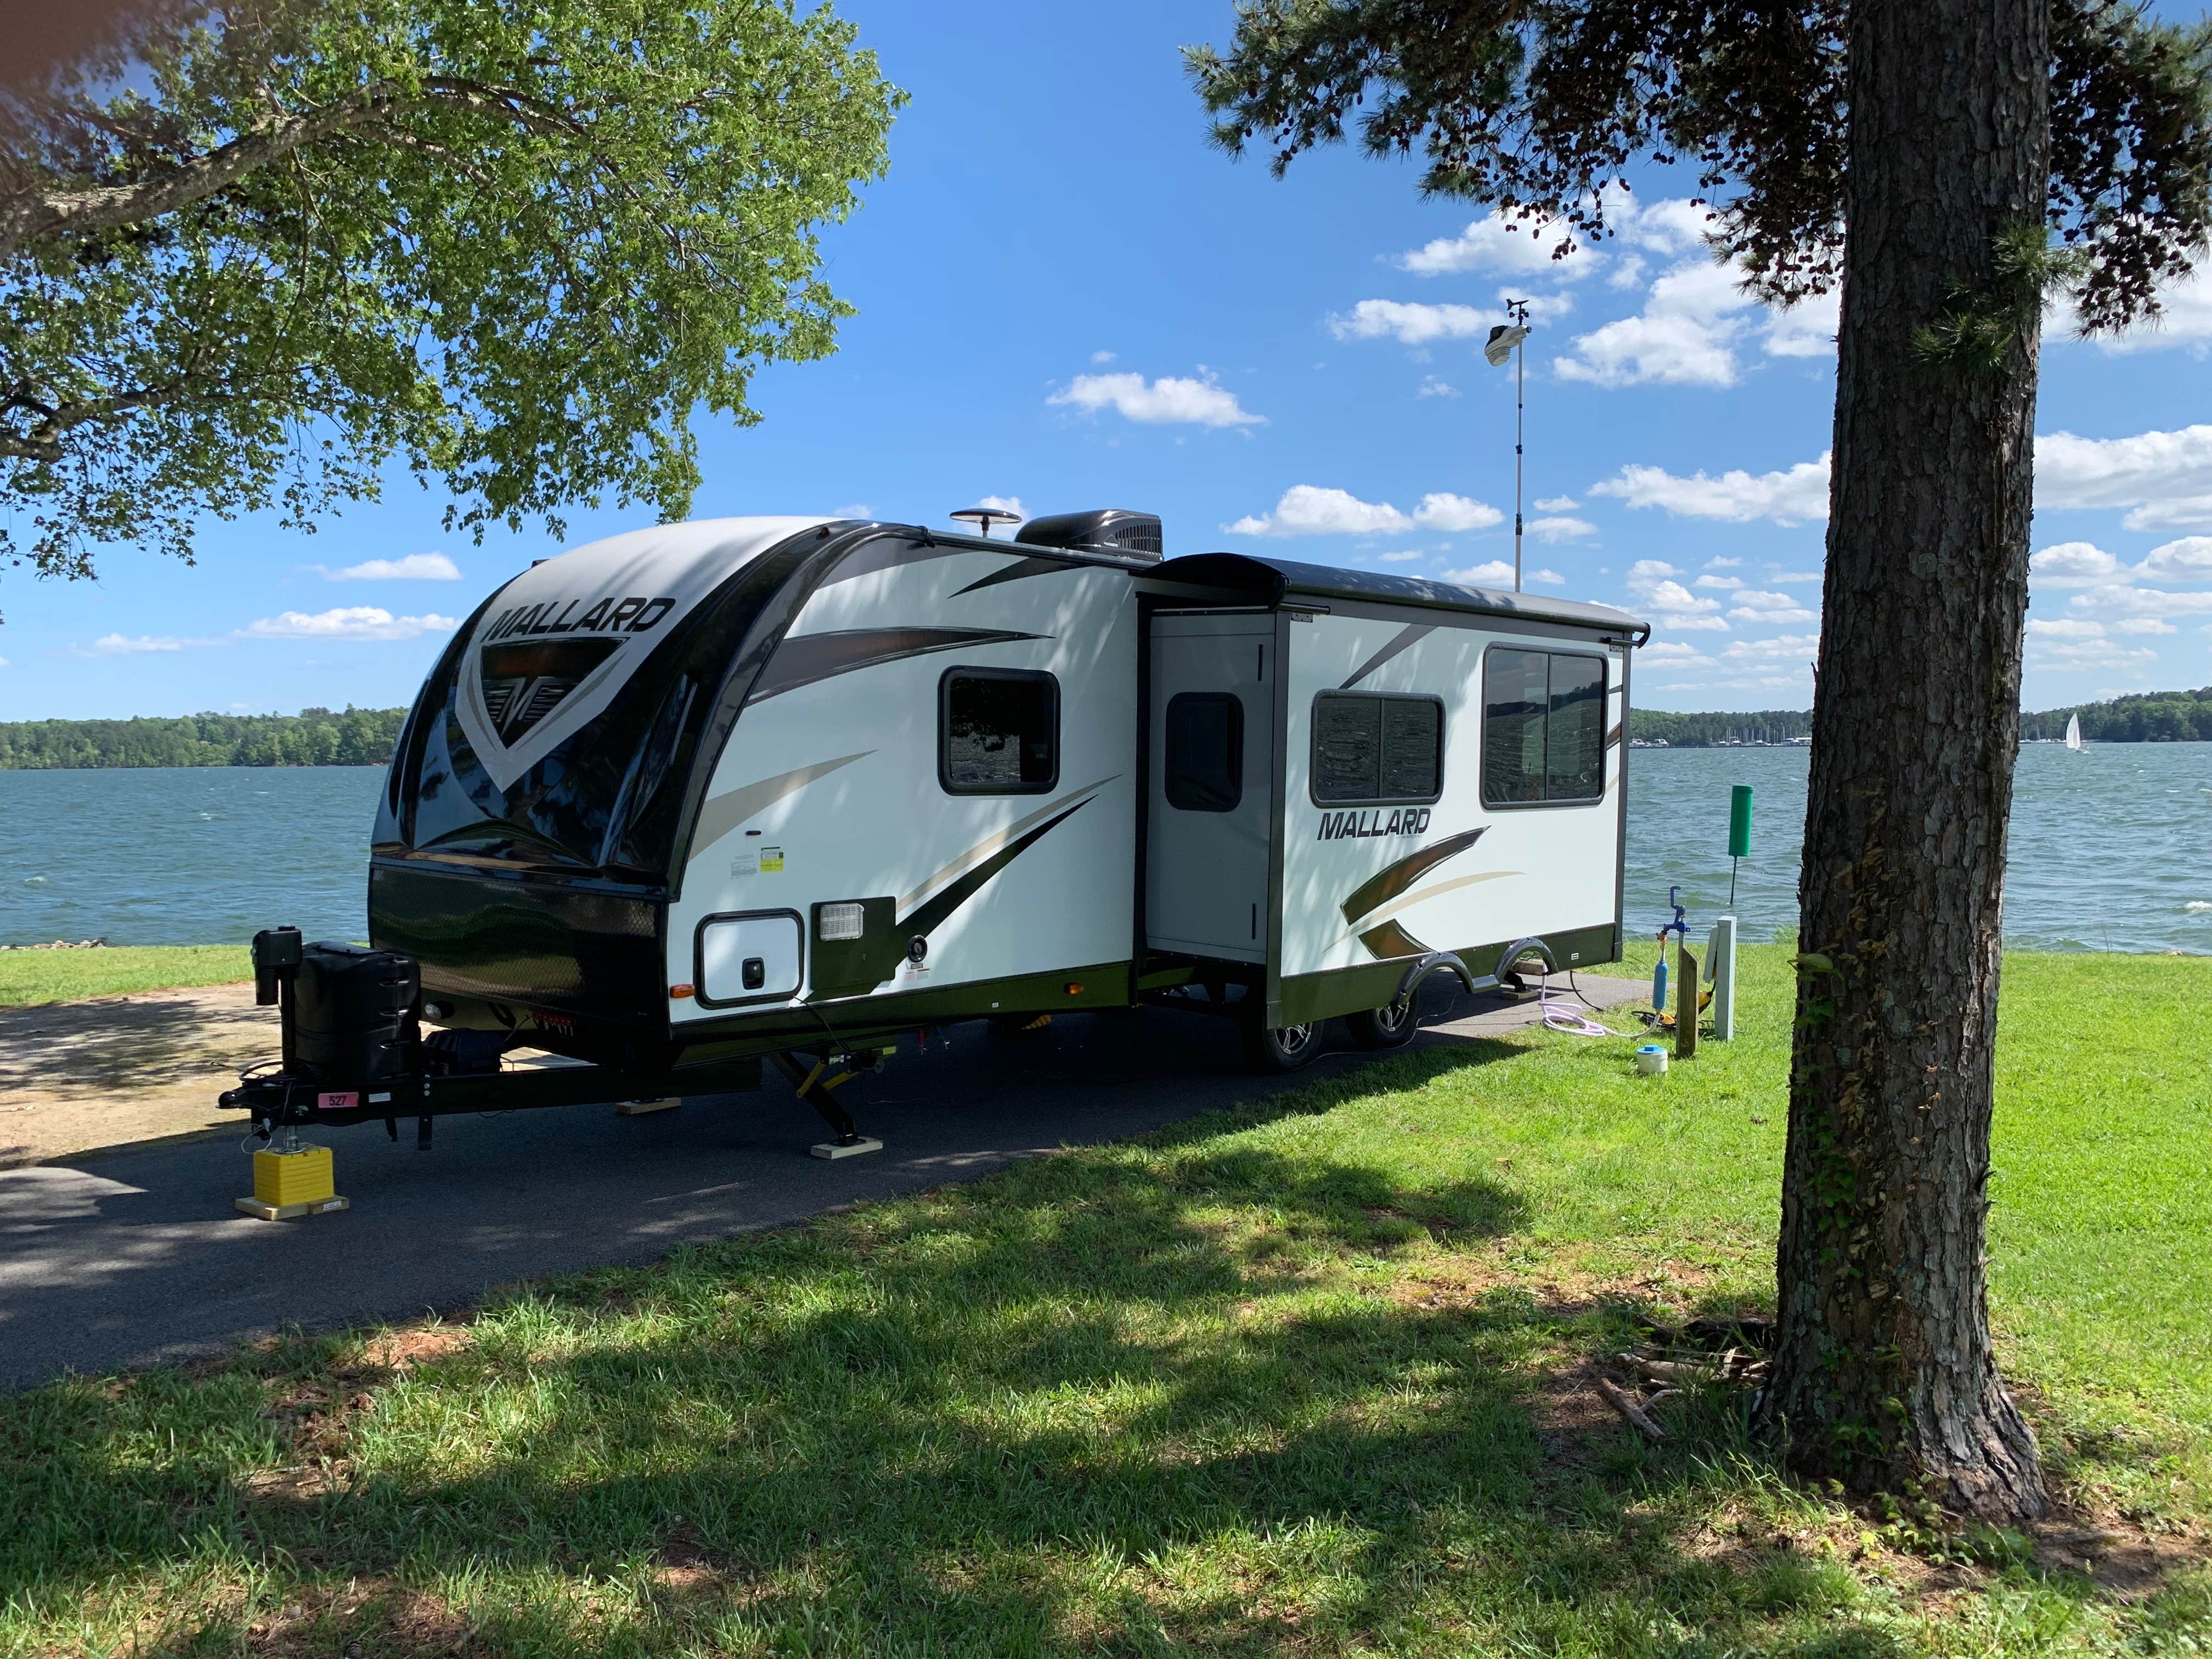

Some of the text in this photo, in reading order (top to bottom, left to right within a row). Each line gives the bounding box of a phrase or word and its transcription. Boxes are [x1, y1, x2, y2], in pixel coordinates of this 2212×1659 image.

[479, 597, 676, 643] MALLARD
[1317, 808, 1431, 840] MALLARD
[329, 1096, 347, 1106] 527
